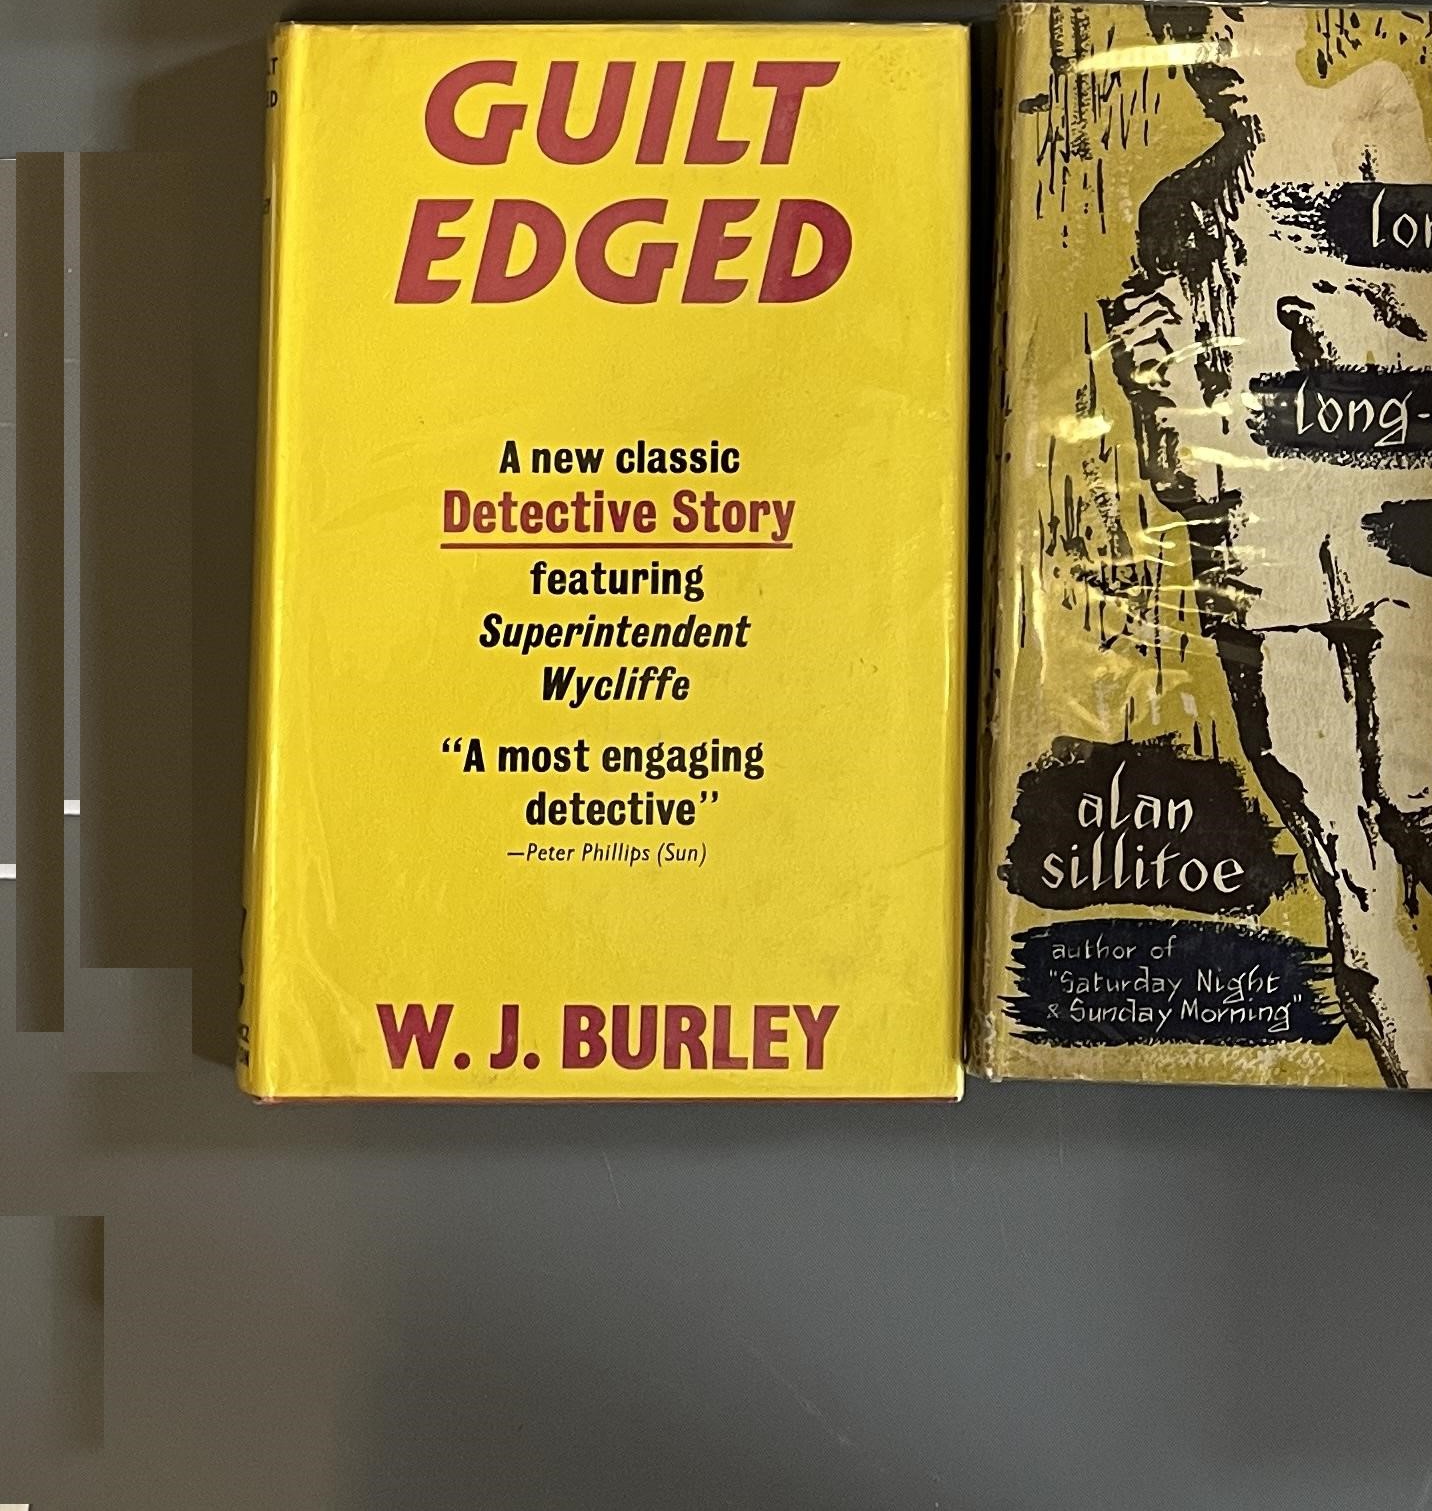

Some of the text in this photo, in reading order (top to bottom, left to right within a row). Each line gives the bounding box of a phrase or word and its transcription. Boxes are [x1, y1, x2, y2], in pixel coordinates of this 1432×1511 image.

[425, 60, 840, 166] GUILT
[394, 198, 853, 305] EDGED
[499, 440, 741, 475] A new classic
[443, 490, 795, 544] Detective Story
[530, 561, 705, 601] featuring
[479, 613, 751, 655] Superintendent
[541, 666, 690, 709] Wycliffe
[441, 738, 765, 780] “A most engaging
[525, 792, 720, 827] detective”
[1077, 759, 1195, 834] alan
[581, 842, 651, 866] Phillips
[657, 843, 708, 867] (Sun)
[1041, 828, 1245, 893] sillitoe
[1051, 934, 1177, 960] author of
[1197, 967, 1281, 1002] Night
[1047, 1003, 1060, 1020] &
[1069, 999, 1173, 1032] Sunday
[376, 1004, 840, 1071] W. J. BURLEY
